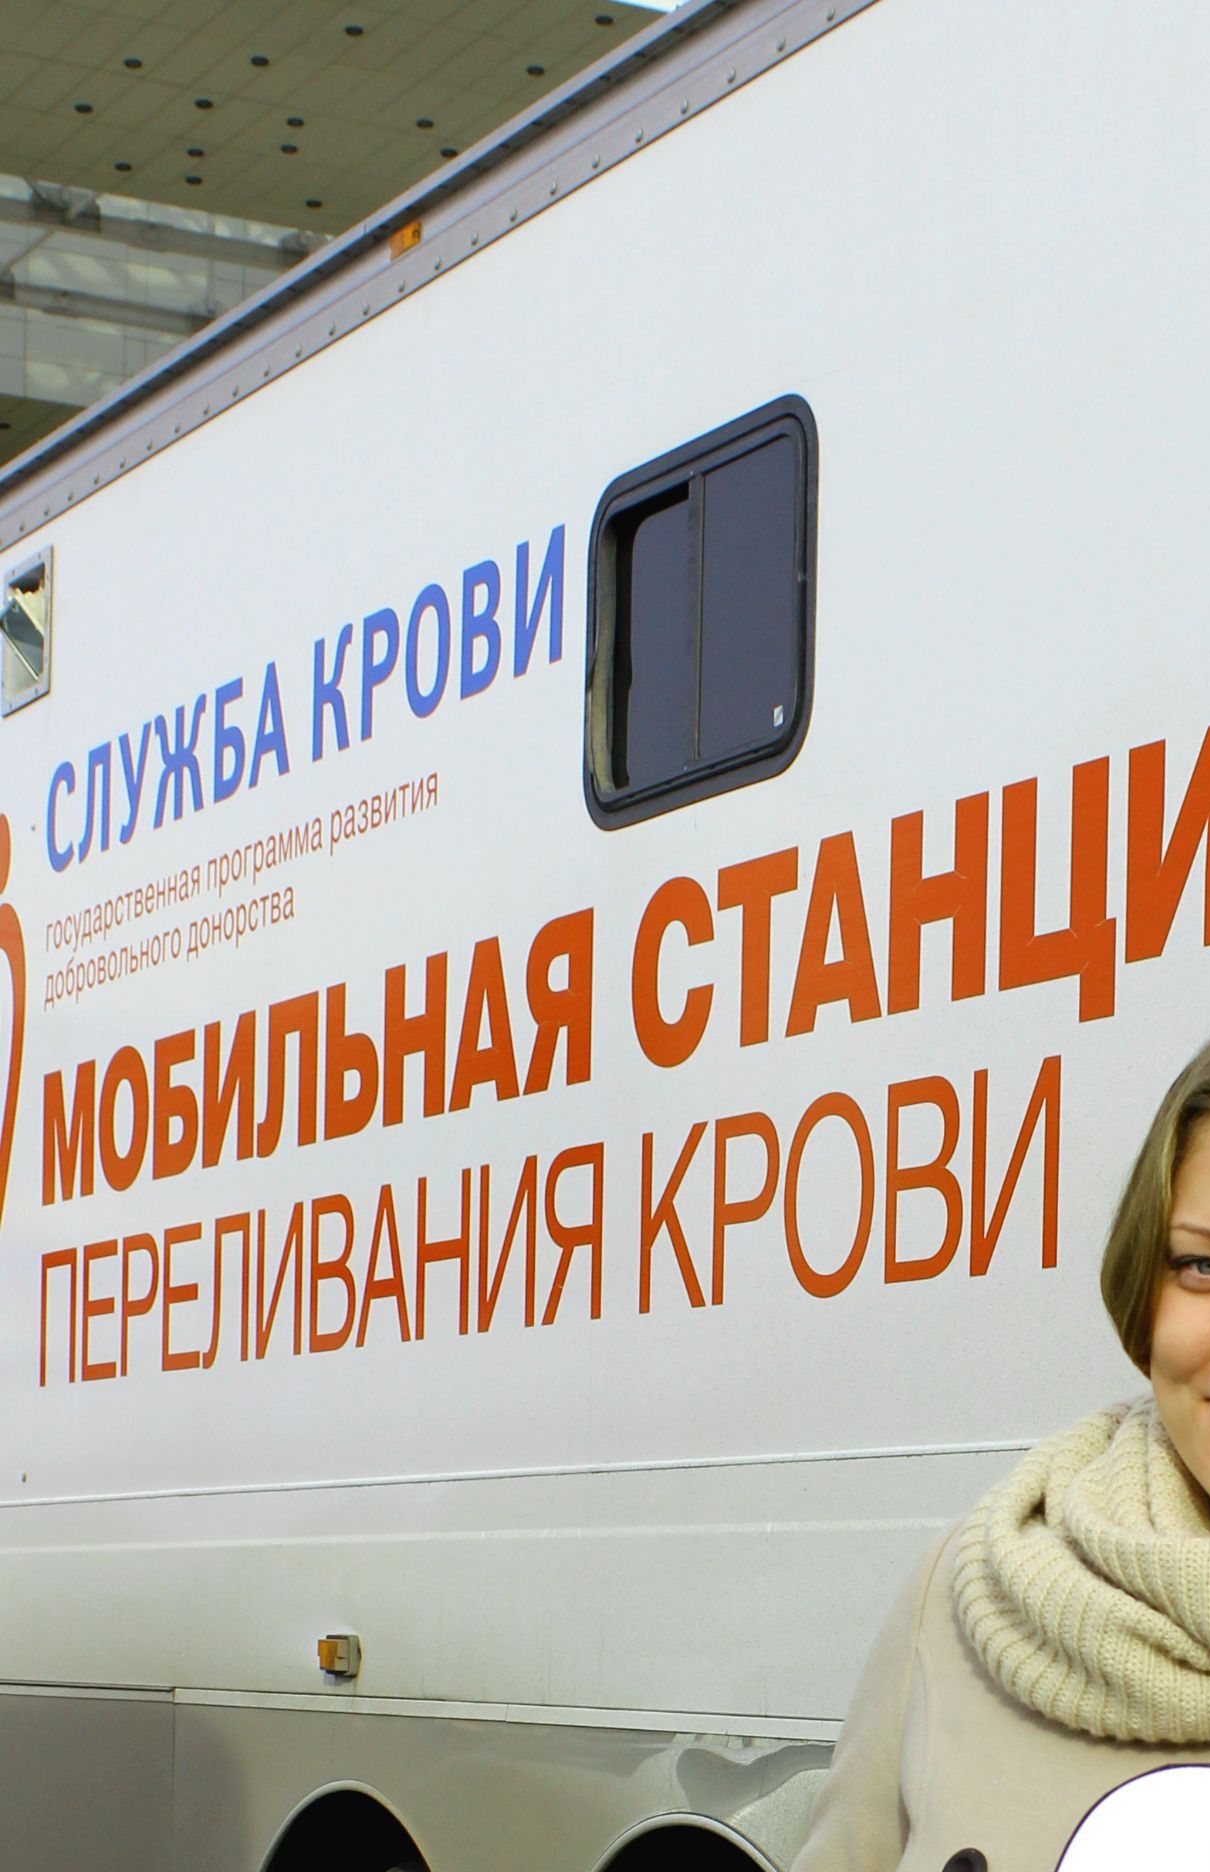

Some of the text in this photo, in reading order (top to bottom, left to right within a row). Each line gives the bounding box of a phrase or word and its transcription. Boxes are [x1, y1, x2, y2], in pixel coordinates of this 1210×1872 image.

[46, 524, 565, 873] СЛУЖБА КРОВИ
[44, 886, 295, 1011] добровольного донорства
[45, 772, 439, 953] государственная программа развития
[42, 906, 595, 1207] МОБИЛЬНАЯ
[40, 1055, 1061, 1387] ПЕРЕЛИВАНИЯ КРОВИ
